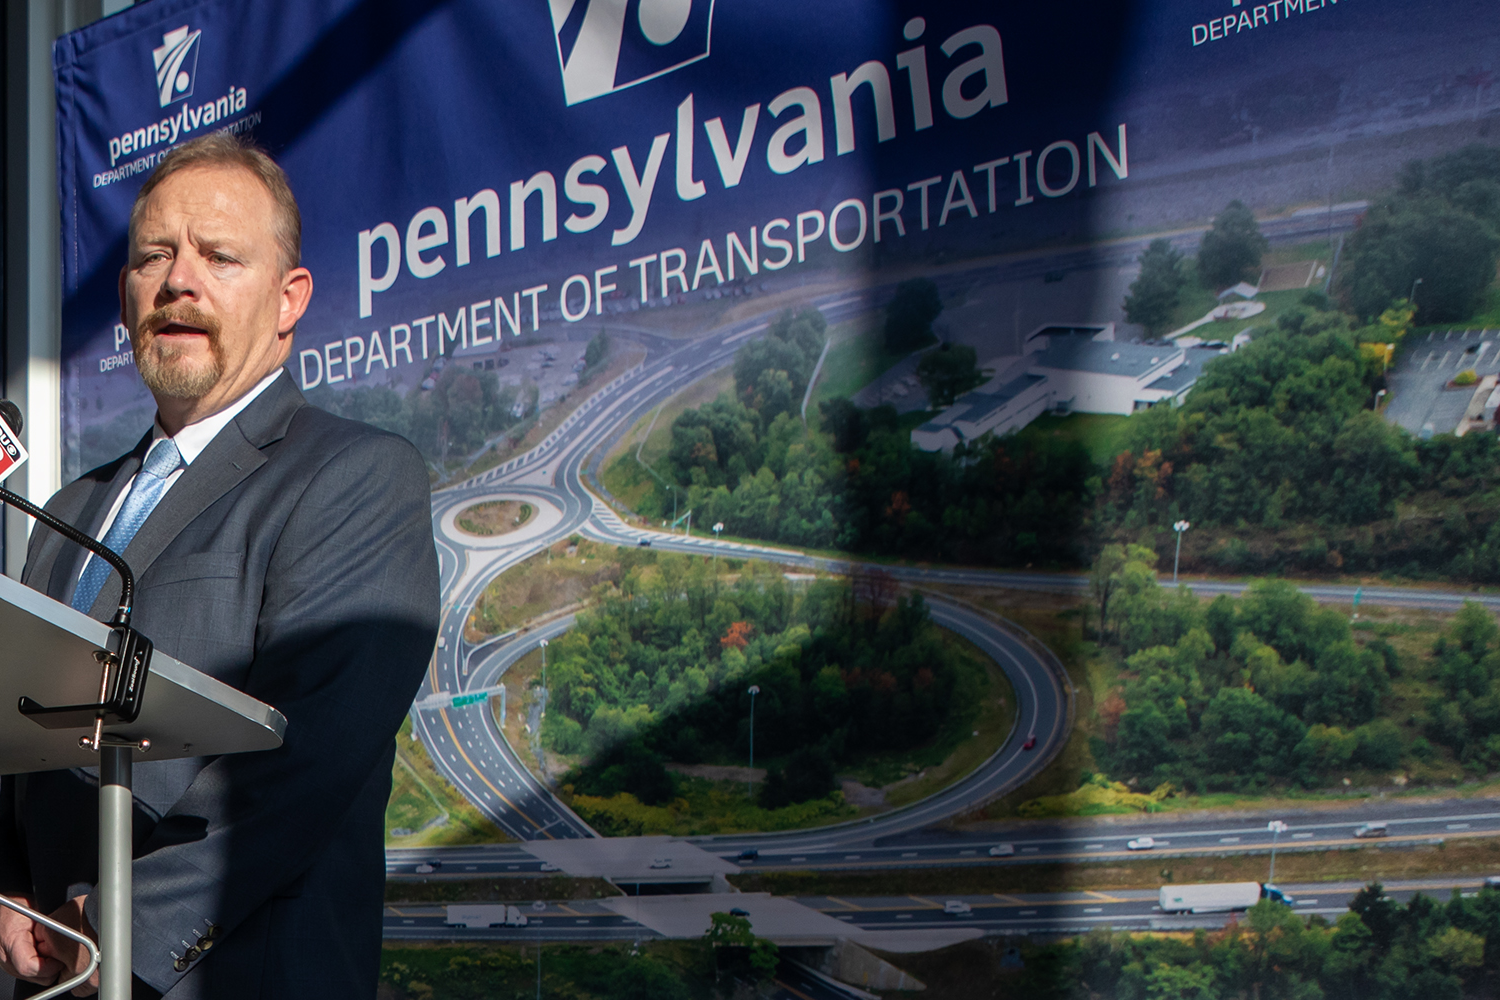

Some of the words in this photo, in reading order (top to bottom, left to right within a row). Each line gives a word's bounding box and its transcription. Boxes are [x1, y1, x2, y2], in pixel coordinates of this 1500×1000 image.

[1191, 0, 1348, 47] DEPARTME
[108, 85, 247, 168] pennsylvania
[92, 152, 157, 189] DEPARTMENT
[357, 16, 1008, 319] pennsylvania
[299, 284, 549, 391] DEPARTMENT
[559, 265, 618, 323] OF
[628, 122, 1129, 304] TRANSPORTATION
[99, 350, 135, 373] DEPART
